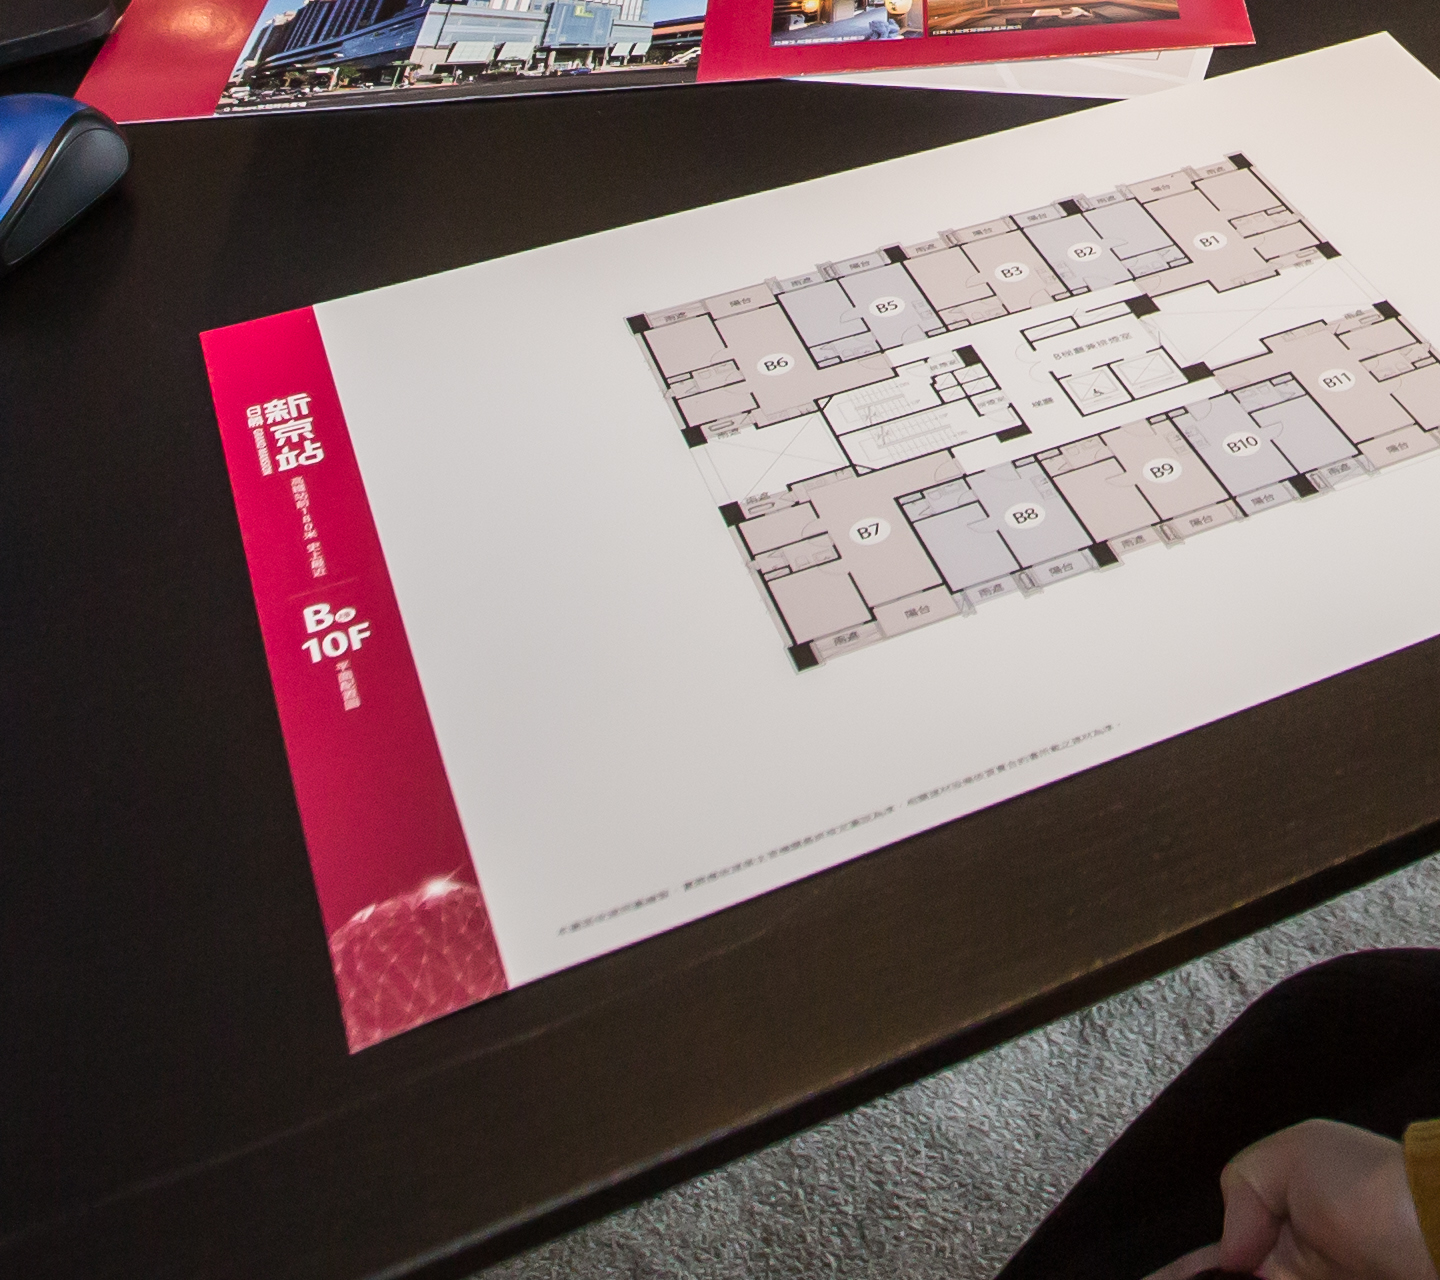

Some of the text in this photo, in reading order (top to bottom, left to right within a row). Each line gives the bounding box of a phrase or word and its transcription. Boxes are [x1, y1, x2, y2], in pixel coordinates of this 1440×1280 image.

[1199, 235, 1221, 249] B1
[1073, 246, 1097, 259] B2
[1000, 265, 1023, 279] B3
[875, 299, 899, 315] B5
[763, 357, 789, 372] B6
[1322, 371, 1353, 389] B11
[263, 392, 326, 472] 新京站
[1226, 435, 1259, 455] B10
[1149, 462, 1175, 480] B9
[1012, 508, 1040, 524] B8
[857, 523, 881, 540] B7
[301, 621, 372, 664] 10F
